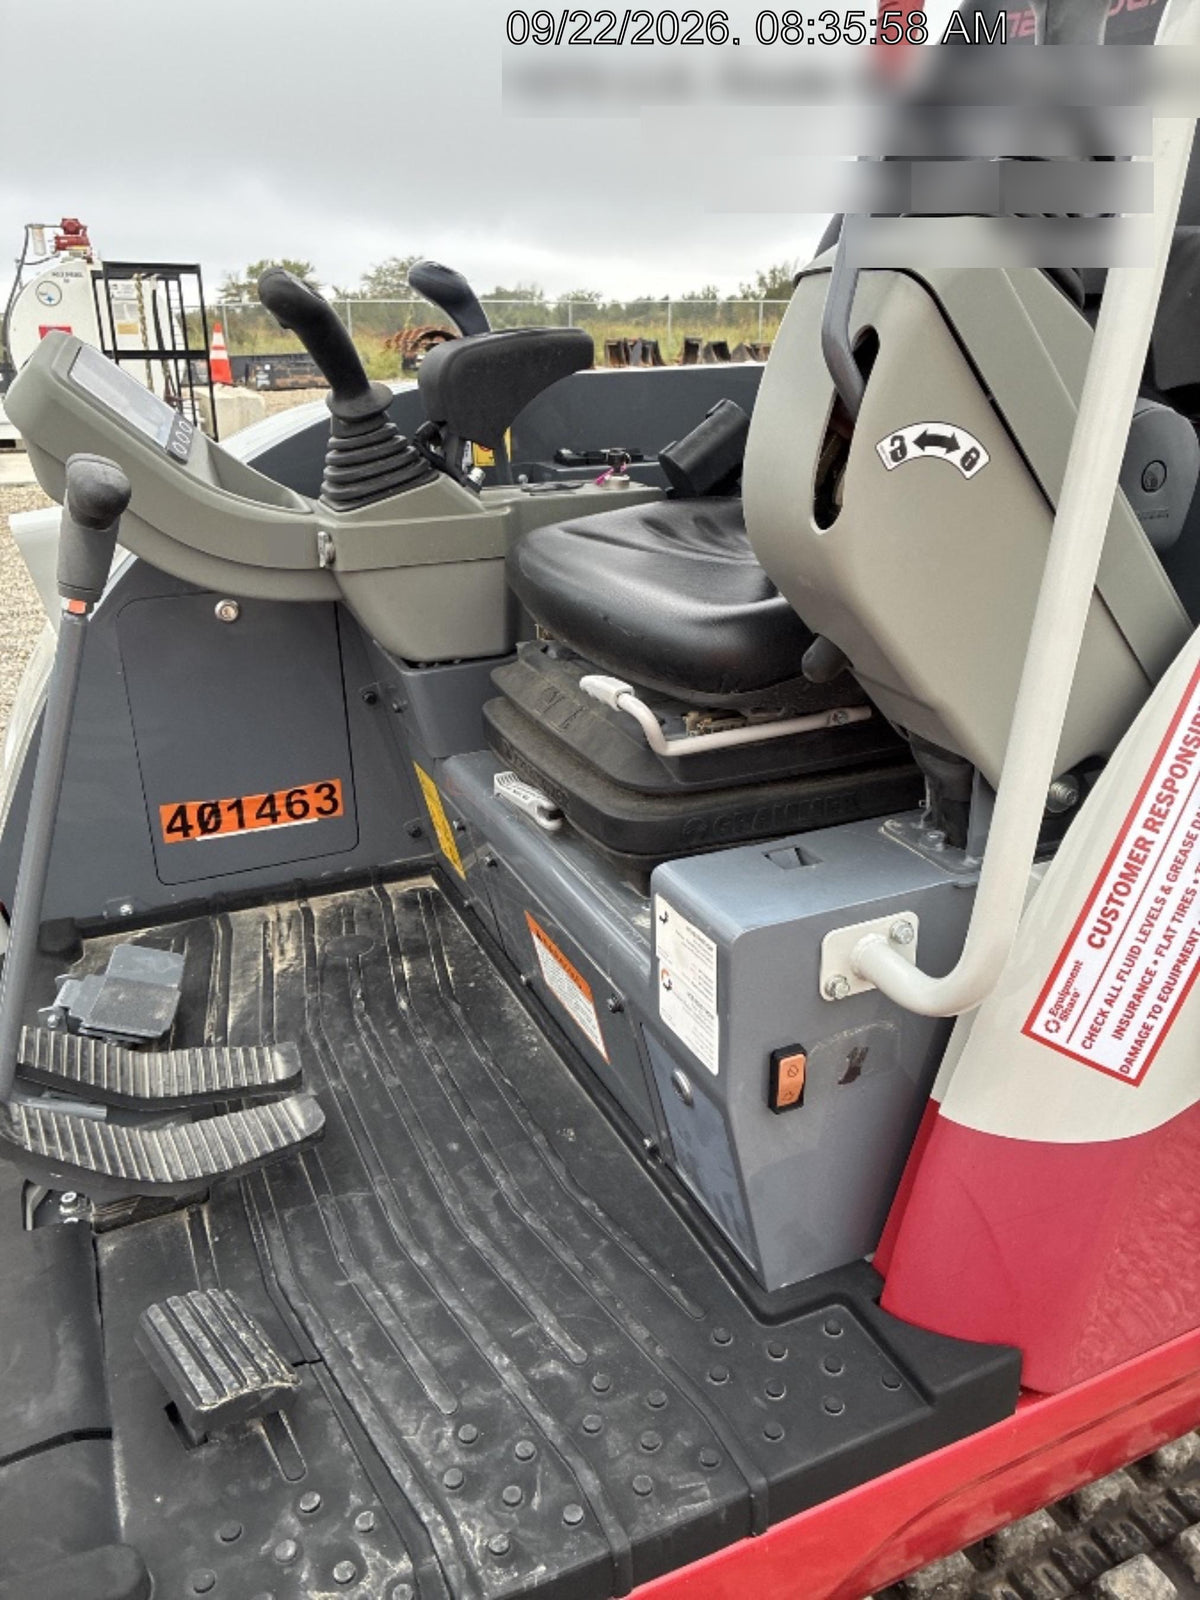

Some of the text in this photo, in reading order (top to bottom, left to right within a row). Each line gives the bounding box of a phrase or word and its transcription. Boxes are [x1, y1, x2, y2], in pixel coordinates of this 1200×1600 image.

[166, 783, 339, 838] 401463
[1081, 830, 1199, 1050] CHECK ALL FLUID LEVELS & GREASE
[1087, 834, 1155, 950] CUSTOMER
[1048, 960, 1084, 1018] Equipment
[1111, 887, 1198, 1040] INSURANCE FLAT TIRES
[1119, 928, 1200, 1074] DAMAGE TO EQUIPMENT
